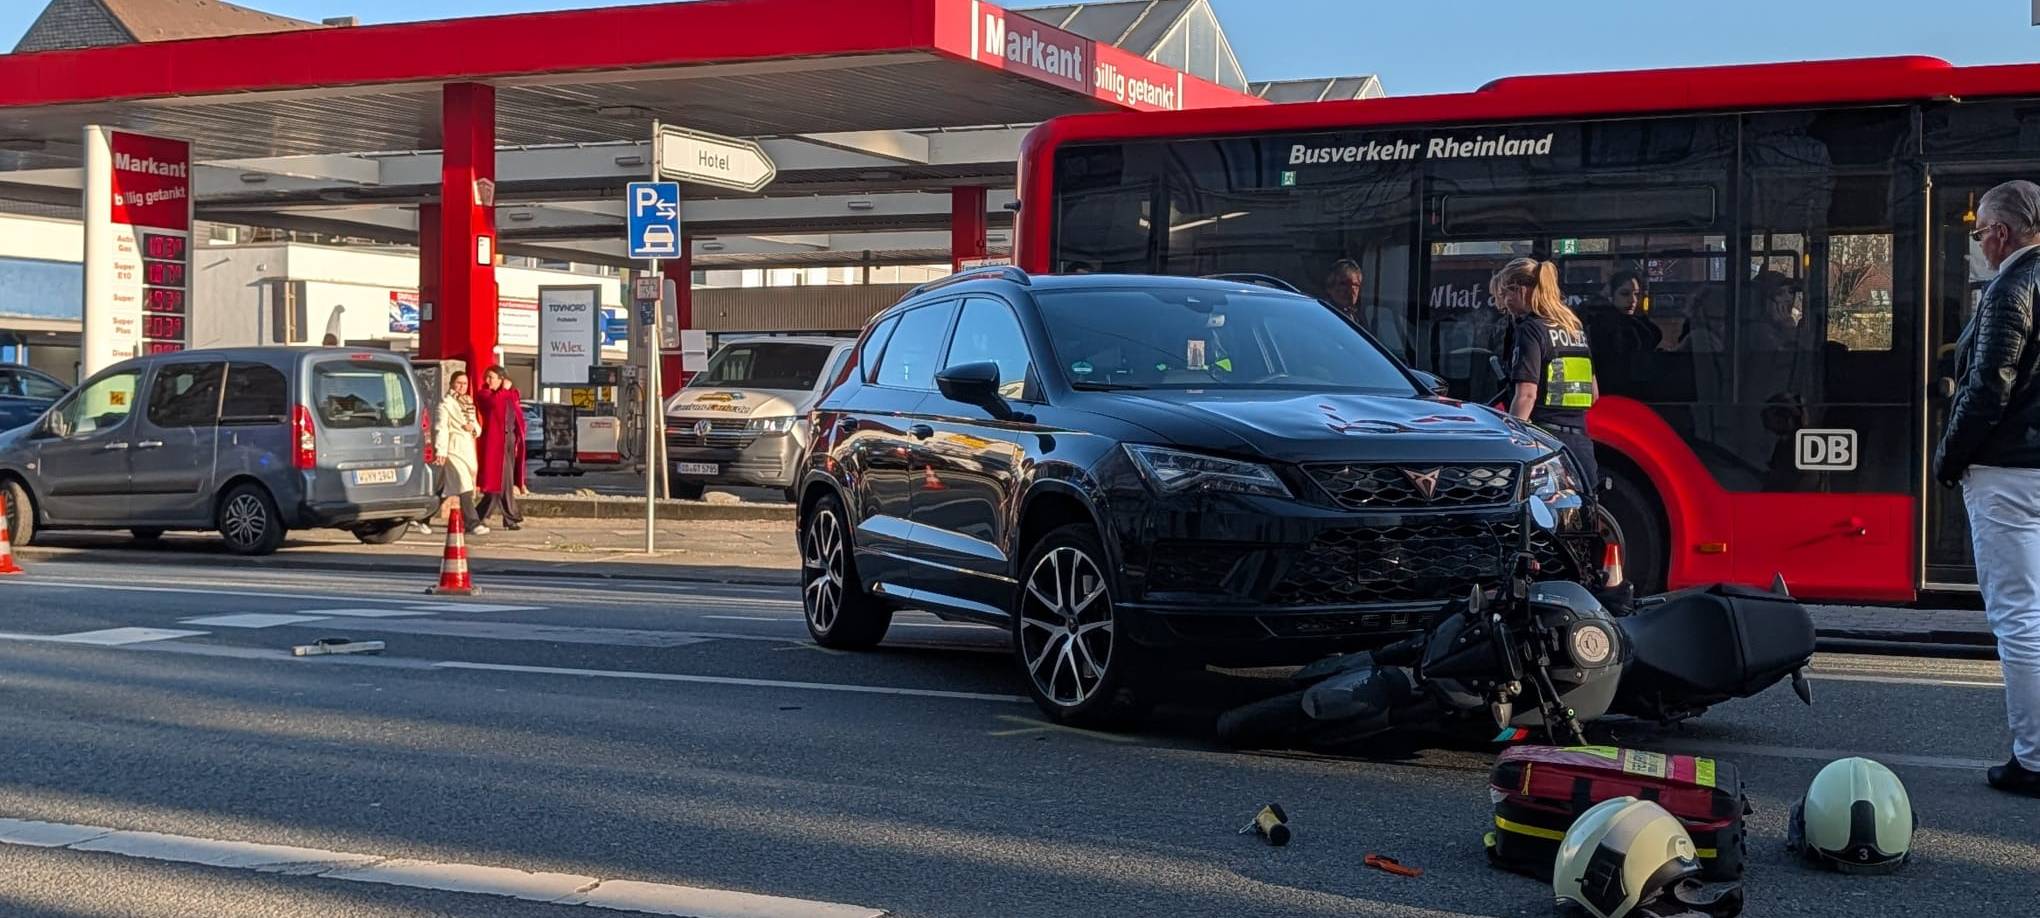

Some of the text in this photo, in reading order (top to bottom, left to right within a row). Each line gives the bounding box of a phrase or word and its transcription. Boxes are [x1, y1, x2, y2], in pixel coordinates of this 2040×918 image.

[985, 13, 1082, 82] Markant
[1093, 61, 1175, 111] billig getankt
[1289, 133, 1553, 164] Busverkehr Rheinland
[115, 153, 187, 178] Markant
[699, 150, 730, 171] Hotel
[114, 186, 186, 207] billig getankt
[636, 188, 658, 217] P
[114, 262, 135, 271] Super
[117, 272, 132, 280] E10
[113, 293, 134, 302] Super
[112, 317, 133, 326] Super
[1803, 435, 1850, 464] DB
[1859, 848, 1869, 860] 3
